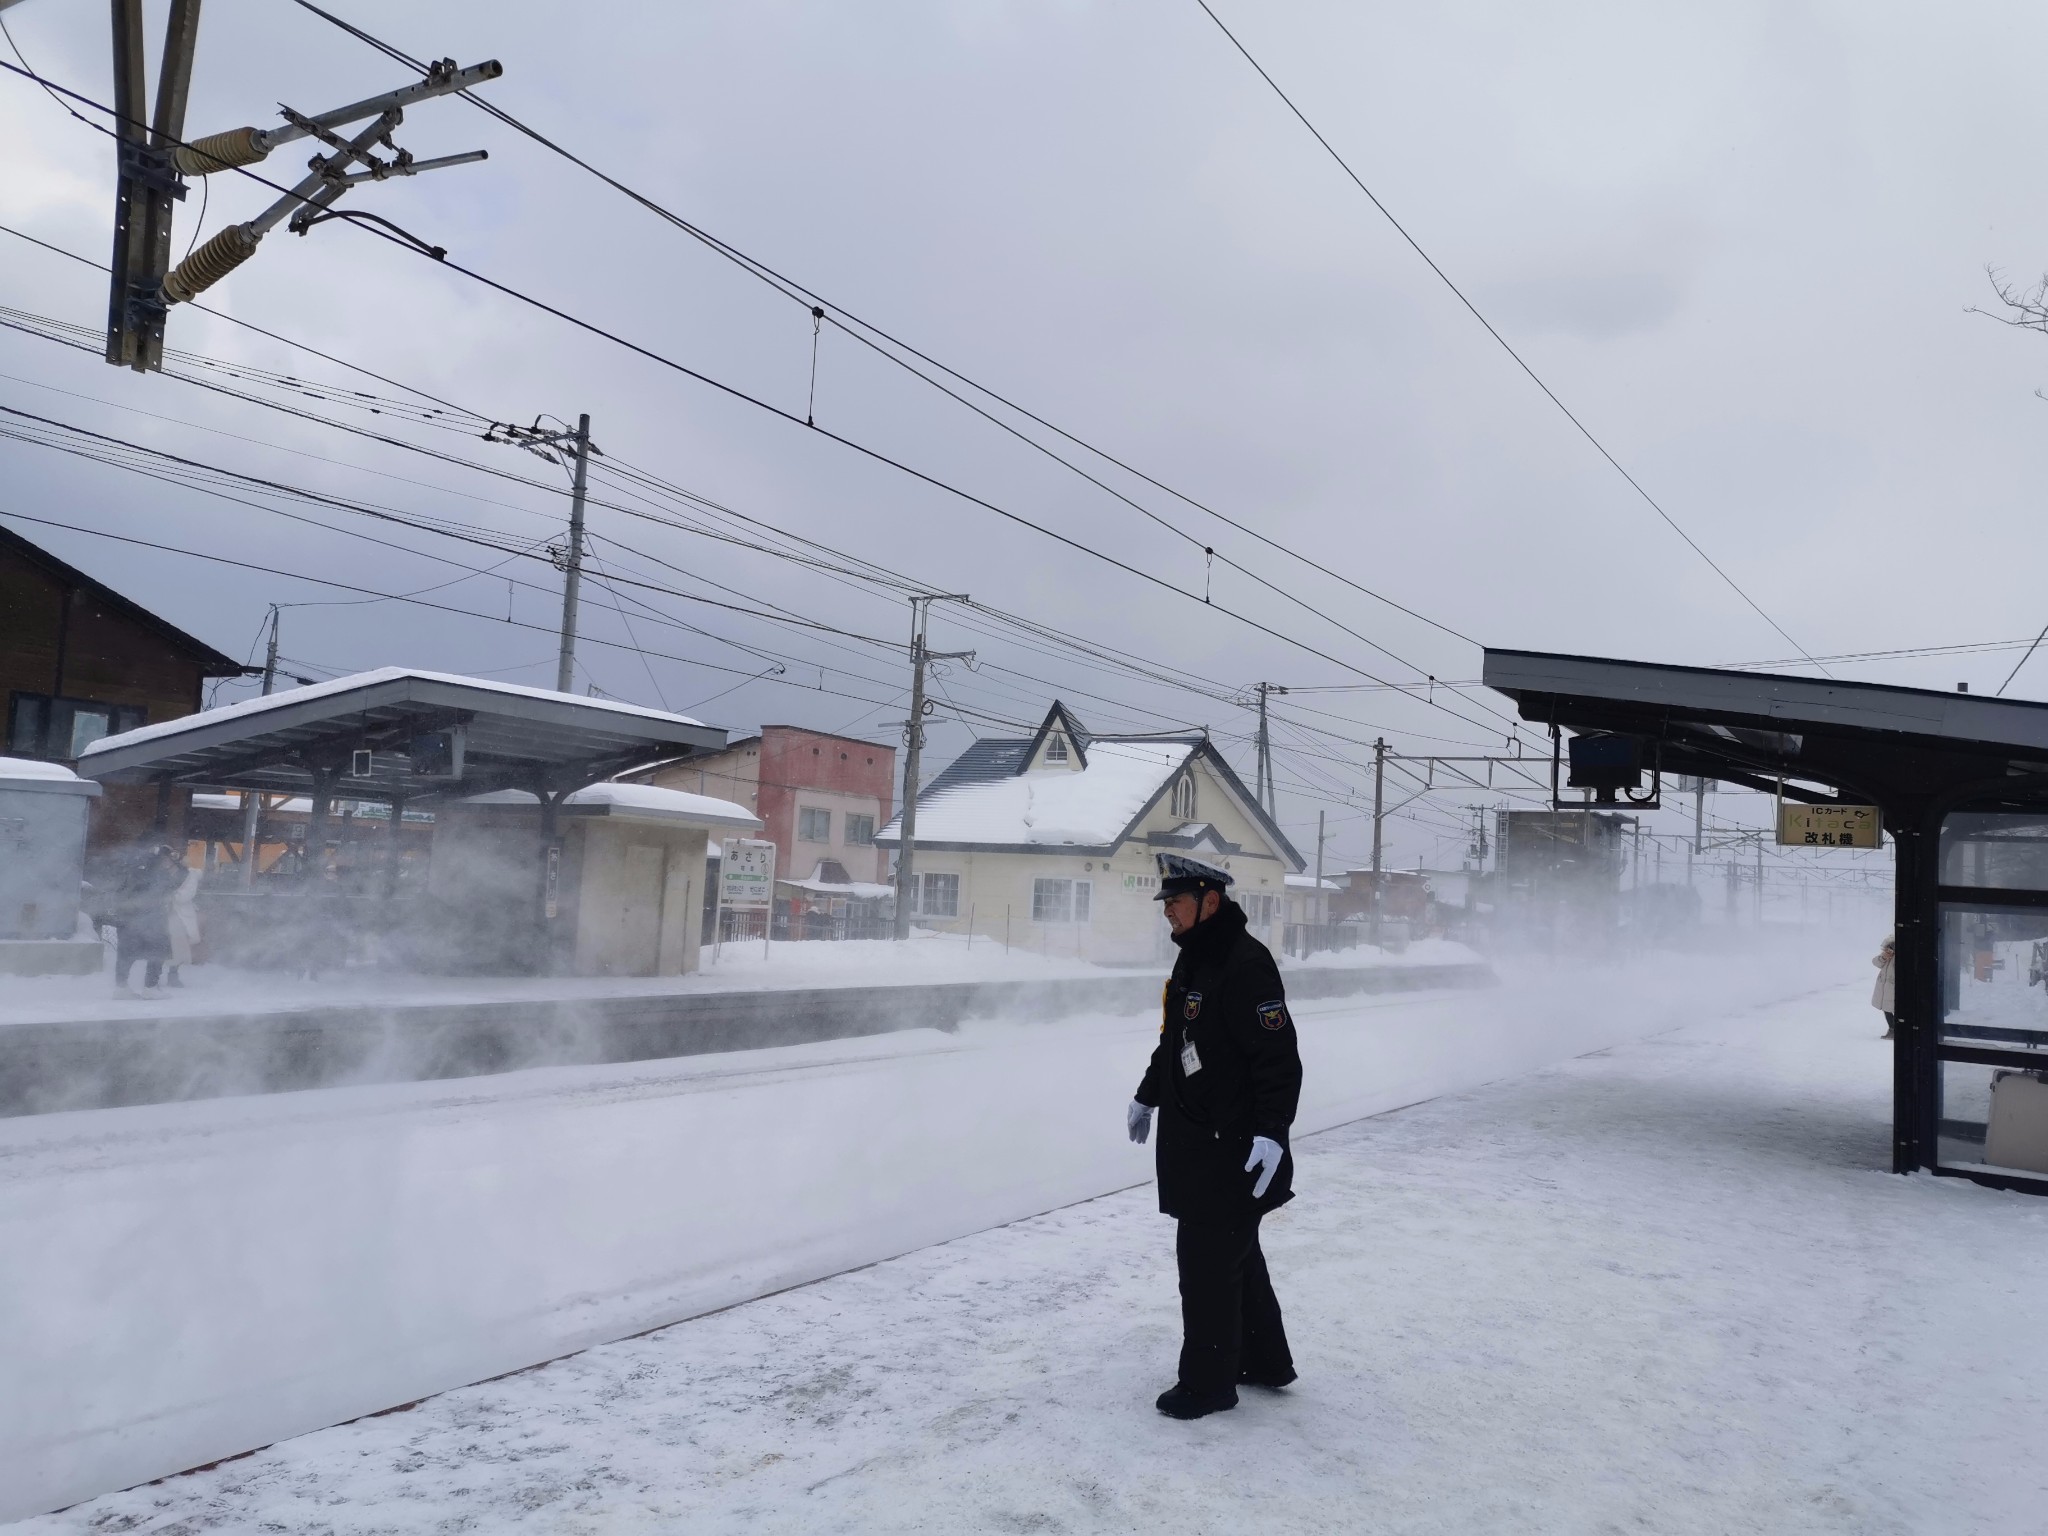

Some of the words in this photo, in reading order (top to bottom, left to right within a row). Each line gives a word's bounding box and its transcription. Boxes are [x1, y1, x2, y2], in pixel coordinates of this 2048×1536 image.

[1789, 814, 1871, 829] Kitaca
[1805, 832, 1853, 845] 改札機
[731, 851, 766, 863] あさり
[550, 853, 558, 898] あさり
[1124, 876, 1136, 888] JR
